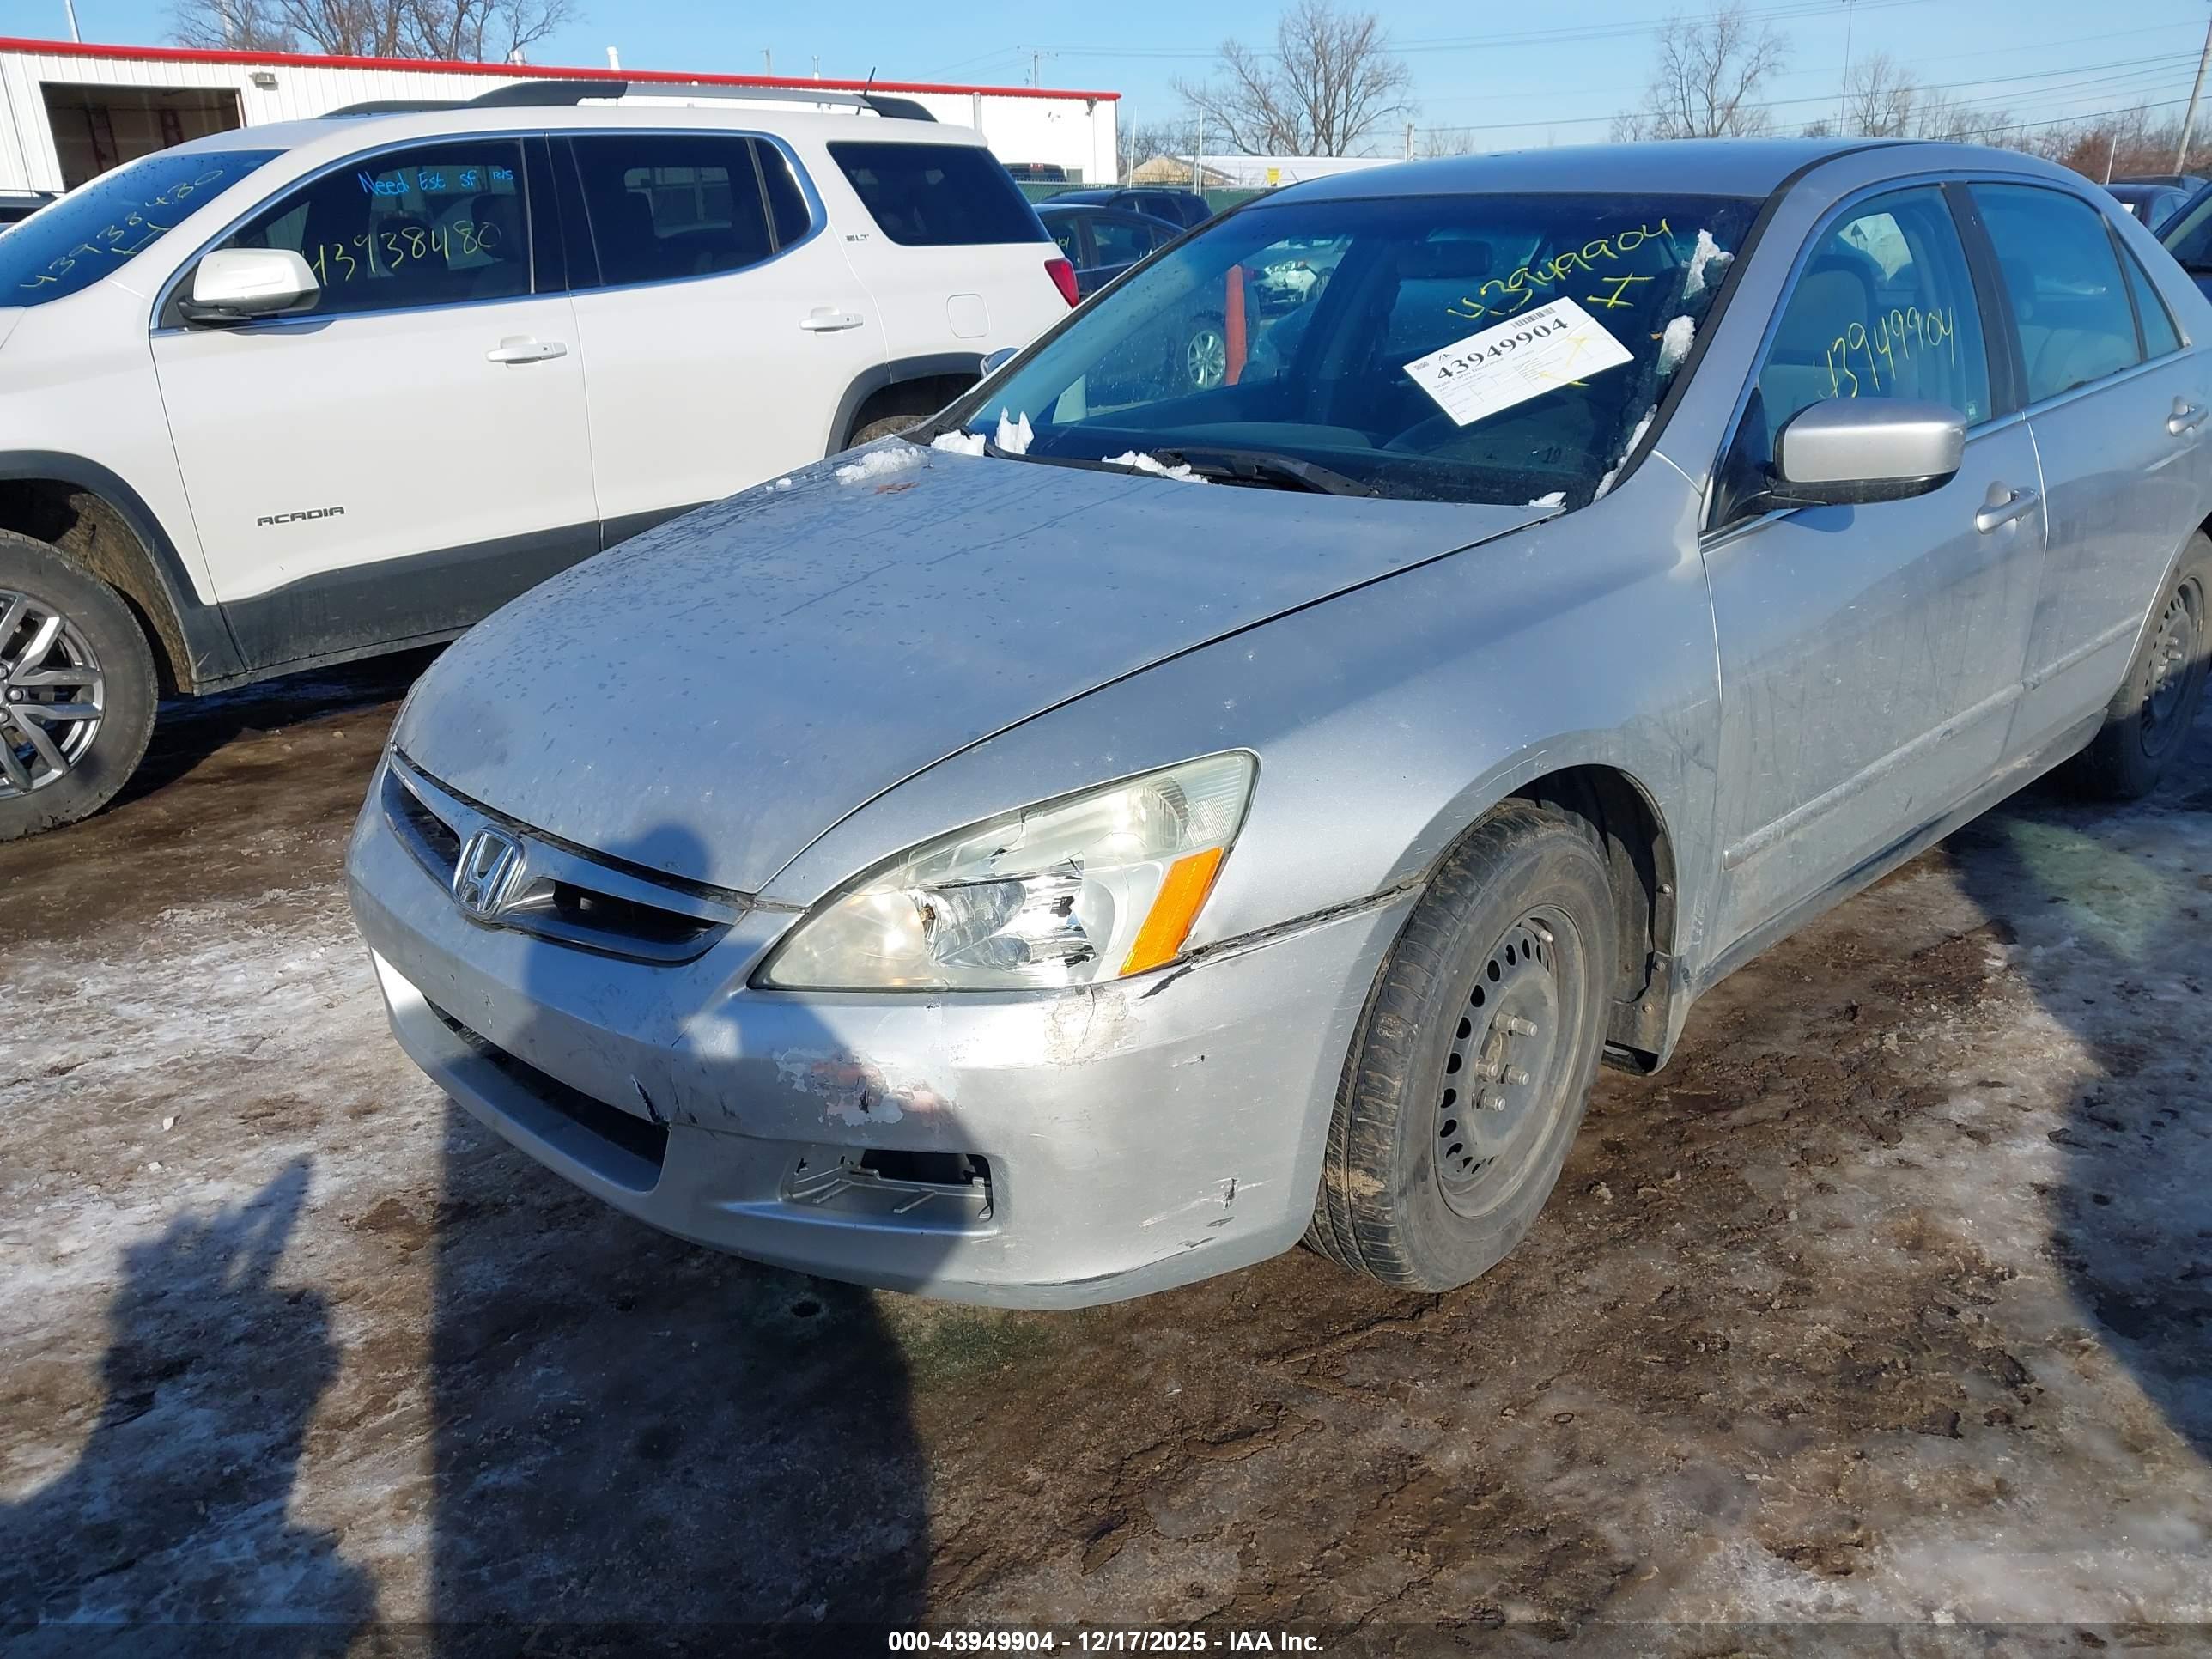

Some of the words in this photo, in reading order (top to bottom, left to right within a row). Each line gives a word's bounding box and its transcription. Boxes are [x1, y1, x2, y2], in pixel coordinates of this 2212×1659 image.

[357, 171, 410, 196] Need
[418, 172, 447, 191] Est
[845, 234, 870, 242] SLT
[1437, 317, 1569, 379] 43949904
[257, 506, 345, 526] ACADIA
